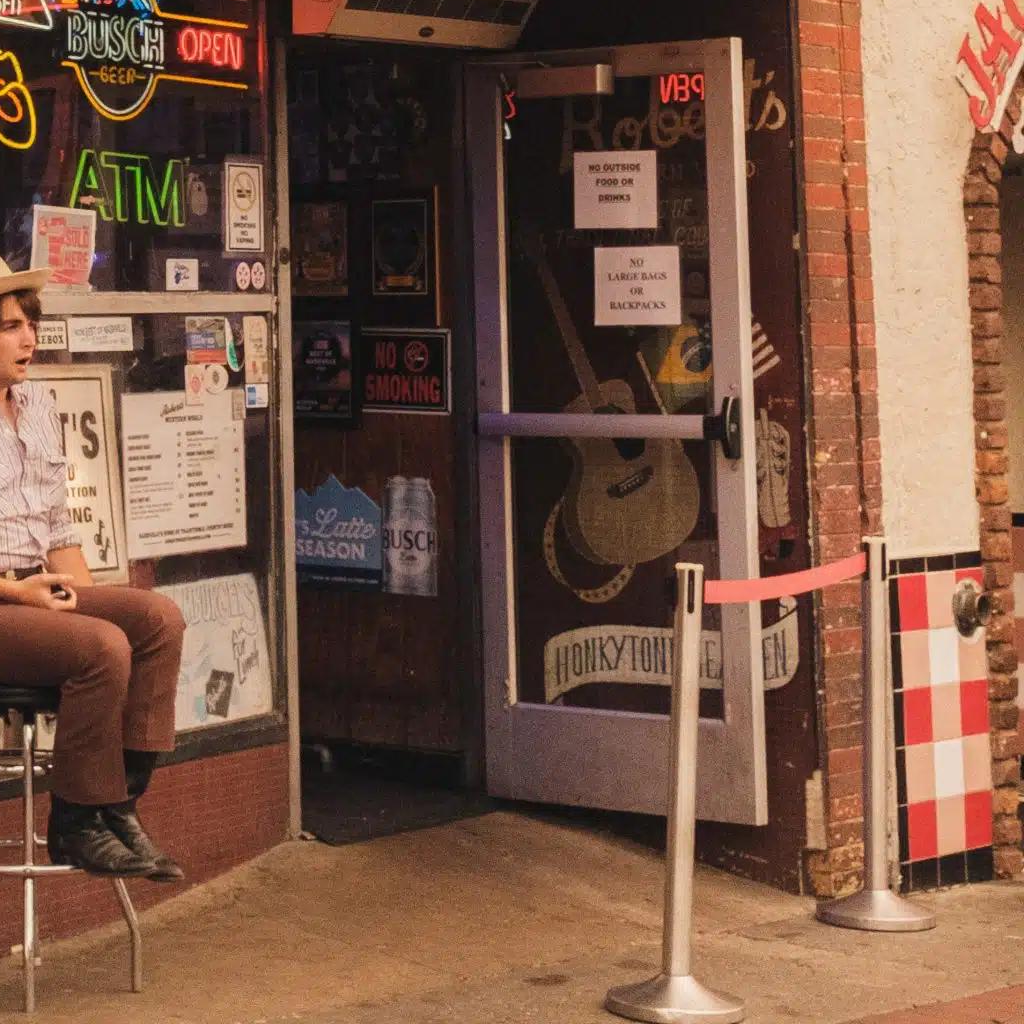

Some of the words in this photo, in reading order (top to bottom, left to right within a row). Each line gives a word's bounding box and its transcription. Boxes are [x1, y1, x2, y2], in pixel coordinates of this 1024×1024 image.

[67, 8, 165, 70] BUSCH
[179, 27, 243, 71] OPEN
[588, 163, 601, 173] NO
[602, 162, 641, 173] OUTSIDE
[69, 148, 186, 227] ATM
[595, 178, 618, 187] FOOD
[620, 178, 635, 187] OR
[598, 193, 632, 203] DRINKS
[629, 257, 644, 268] NO
[607, 272, 639, 281] LARGE
[640, 272, 667, 281] BAGS
[629, 286, 644, 296] OR
[609, 301, 667, 311] BACKPACKS
[375, 341, 397, 369] NO
[364, 373, 441, 404] SMOKING
[296, 538, 367, 561] SEASON
[382, 528, 439, 556] BUSCH
